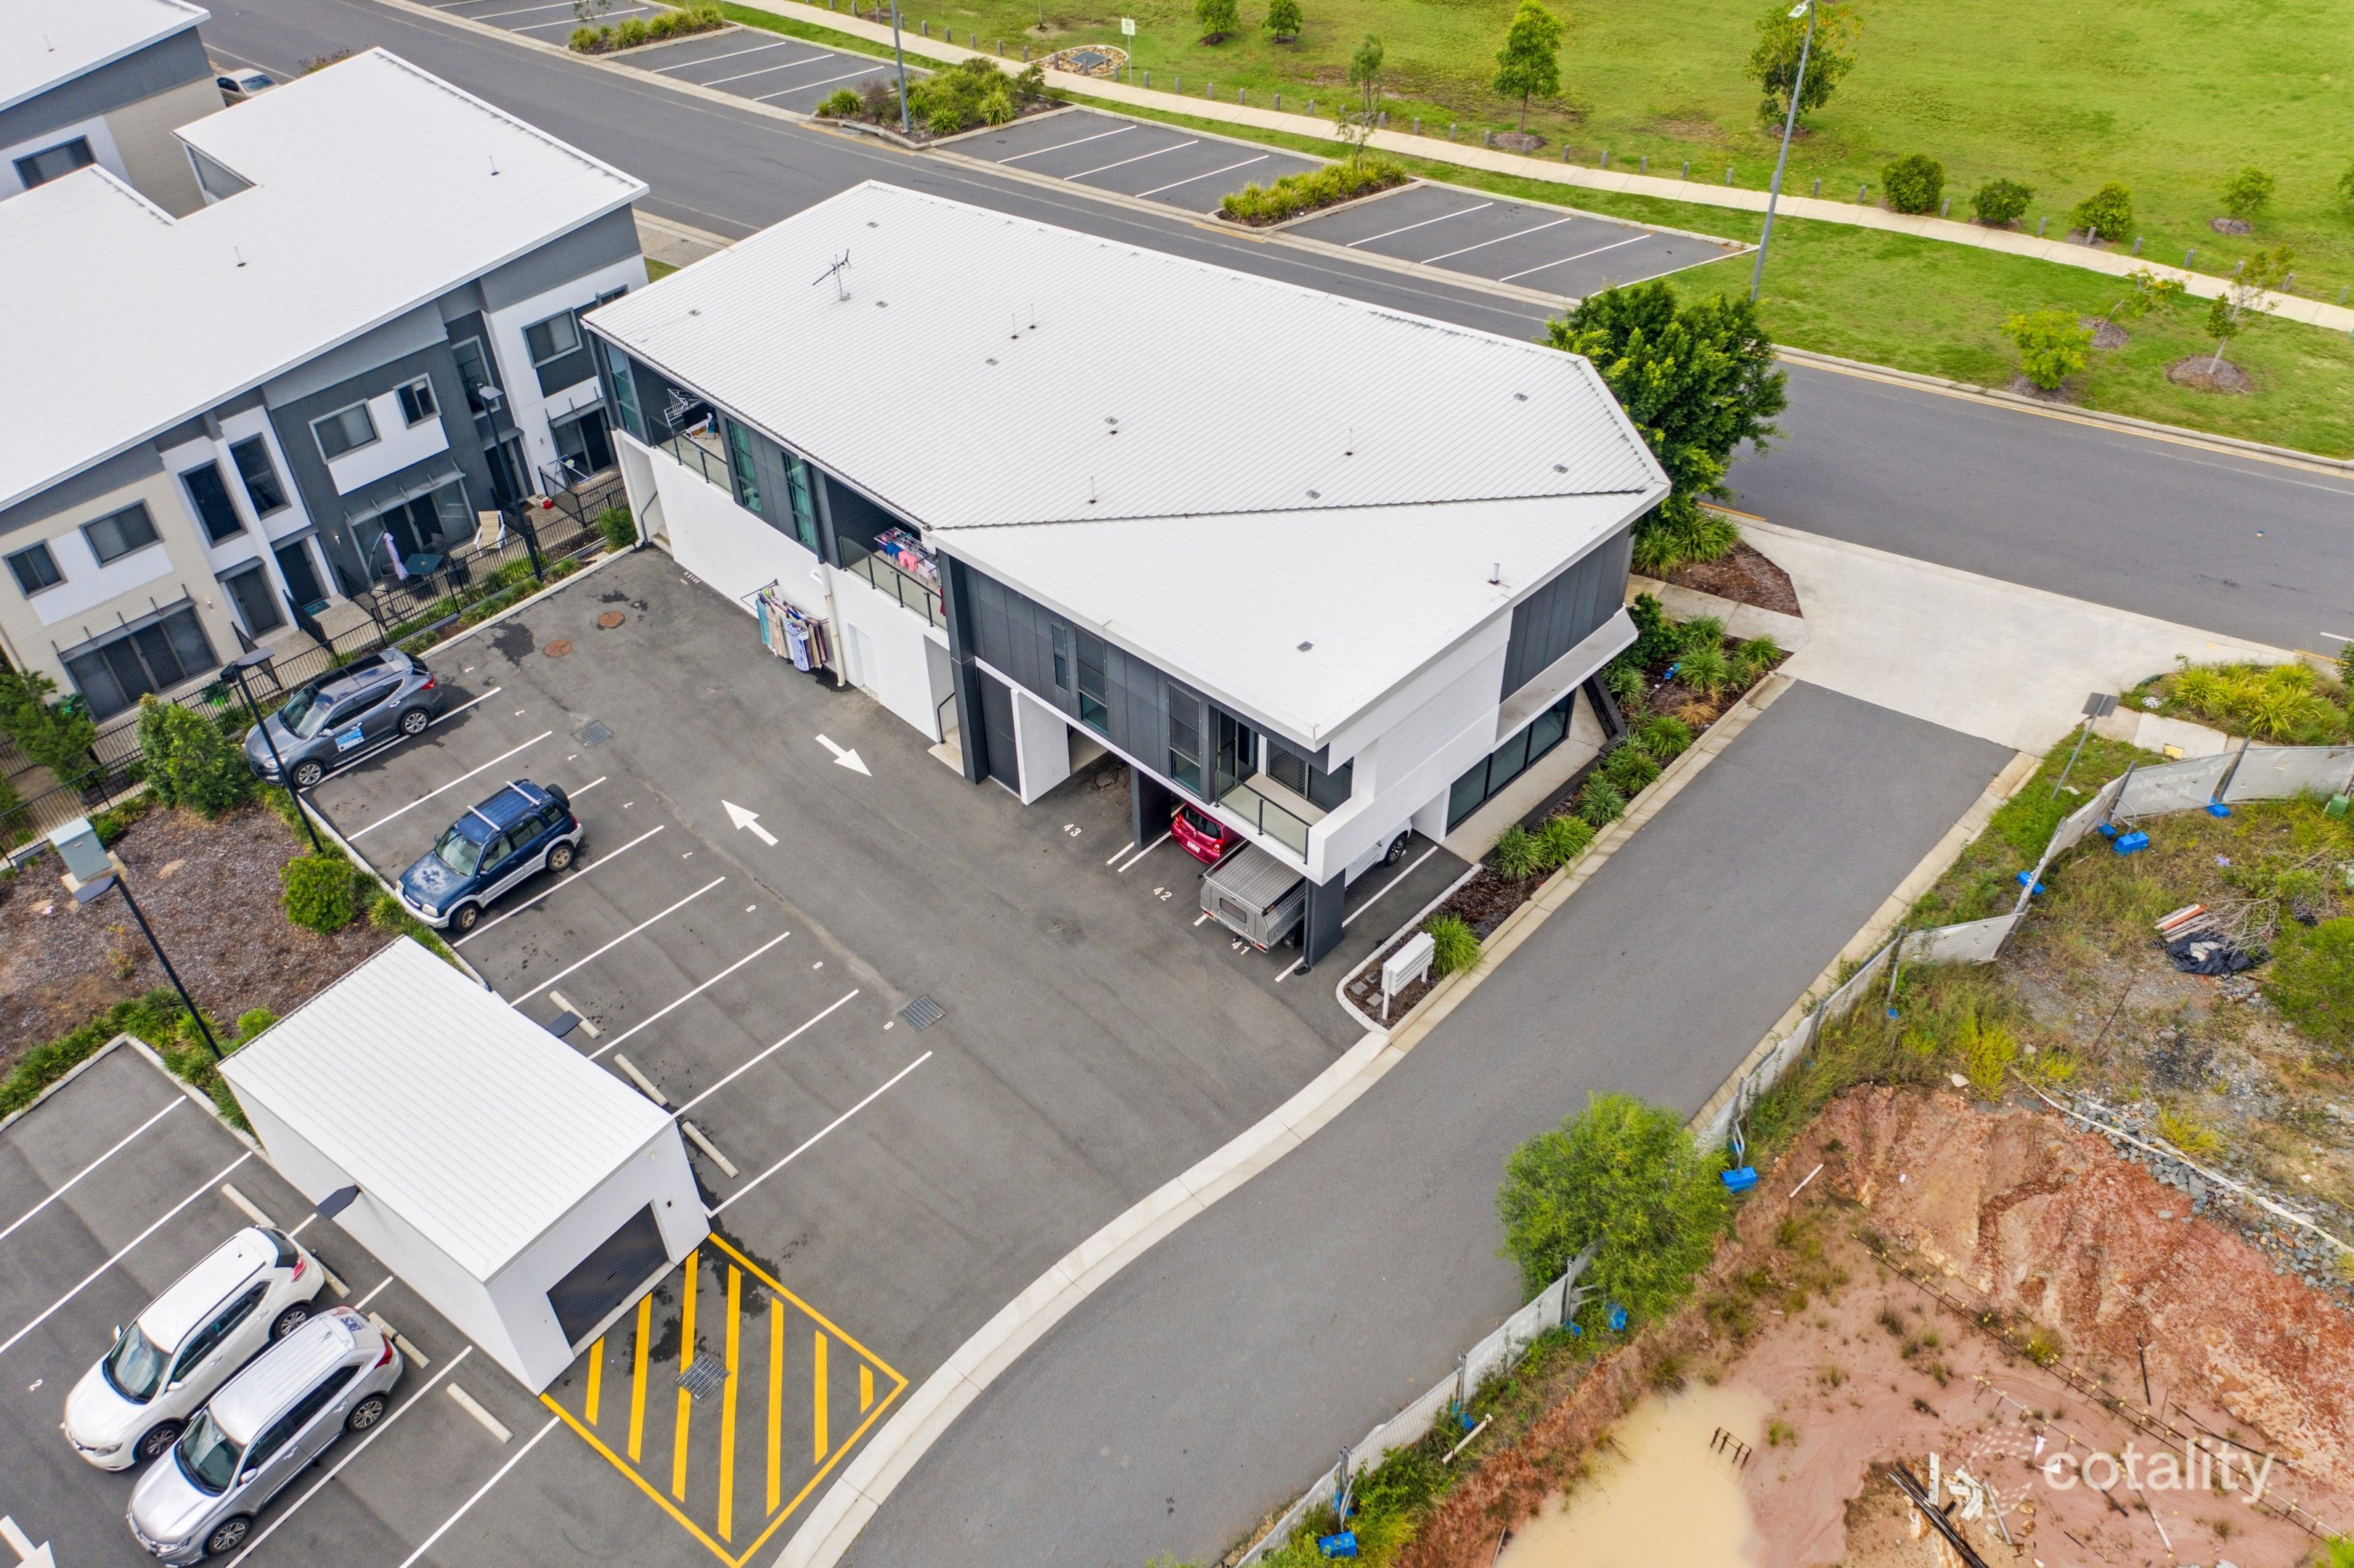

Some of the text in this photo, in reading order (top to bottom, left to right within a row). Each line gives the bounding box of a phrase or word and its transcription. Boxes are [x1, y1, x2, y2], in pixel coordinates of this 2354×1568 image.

[1063, 824, 1081, 836] 43
[1153, 886, 1172, 901] 42
[1231, 942, 1250, 955] 41
[28, 1379, 44, 1392] 2
